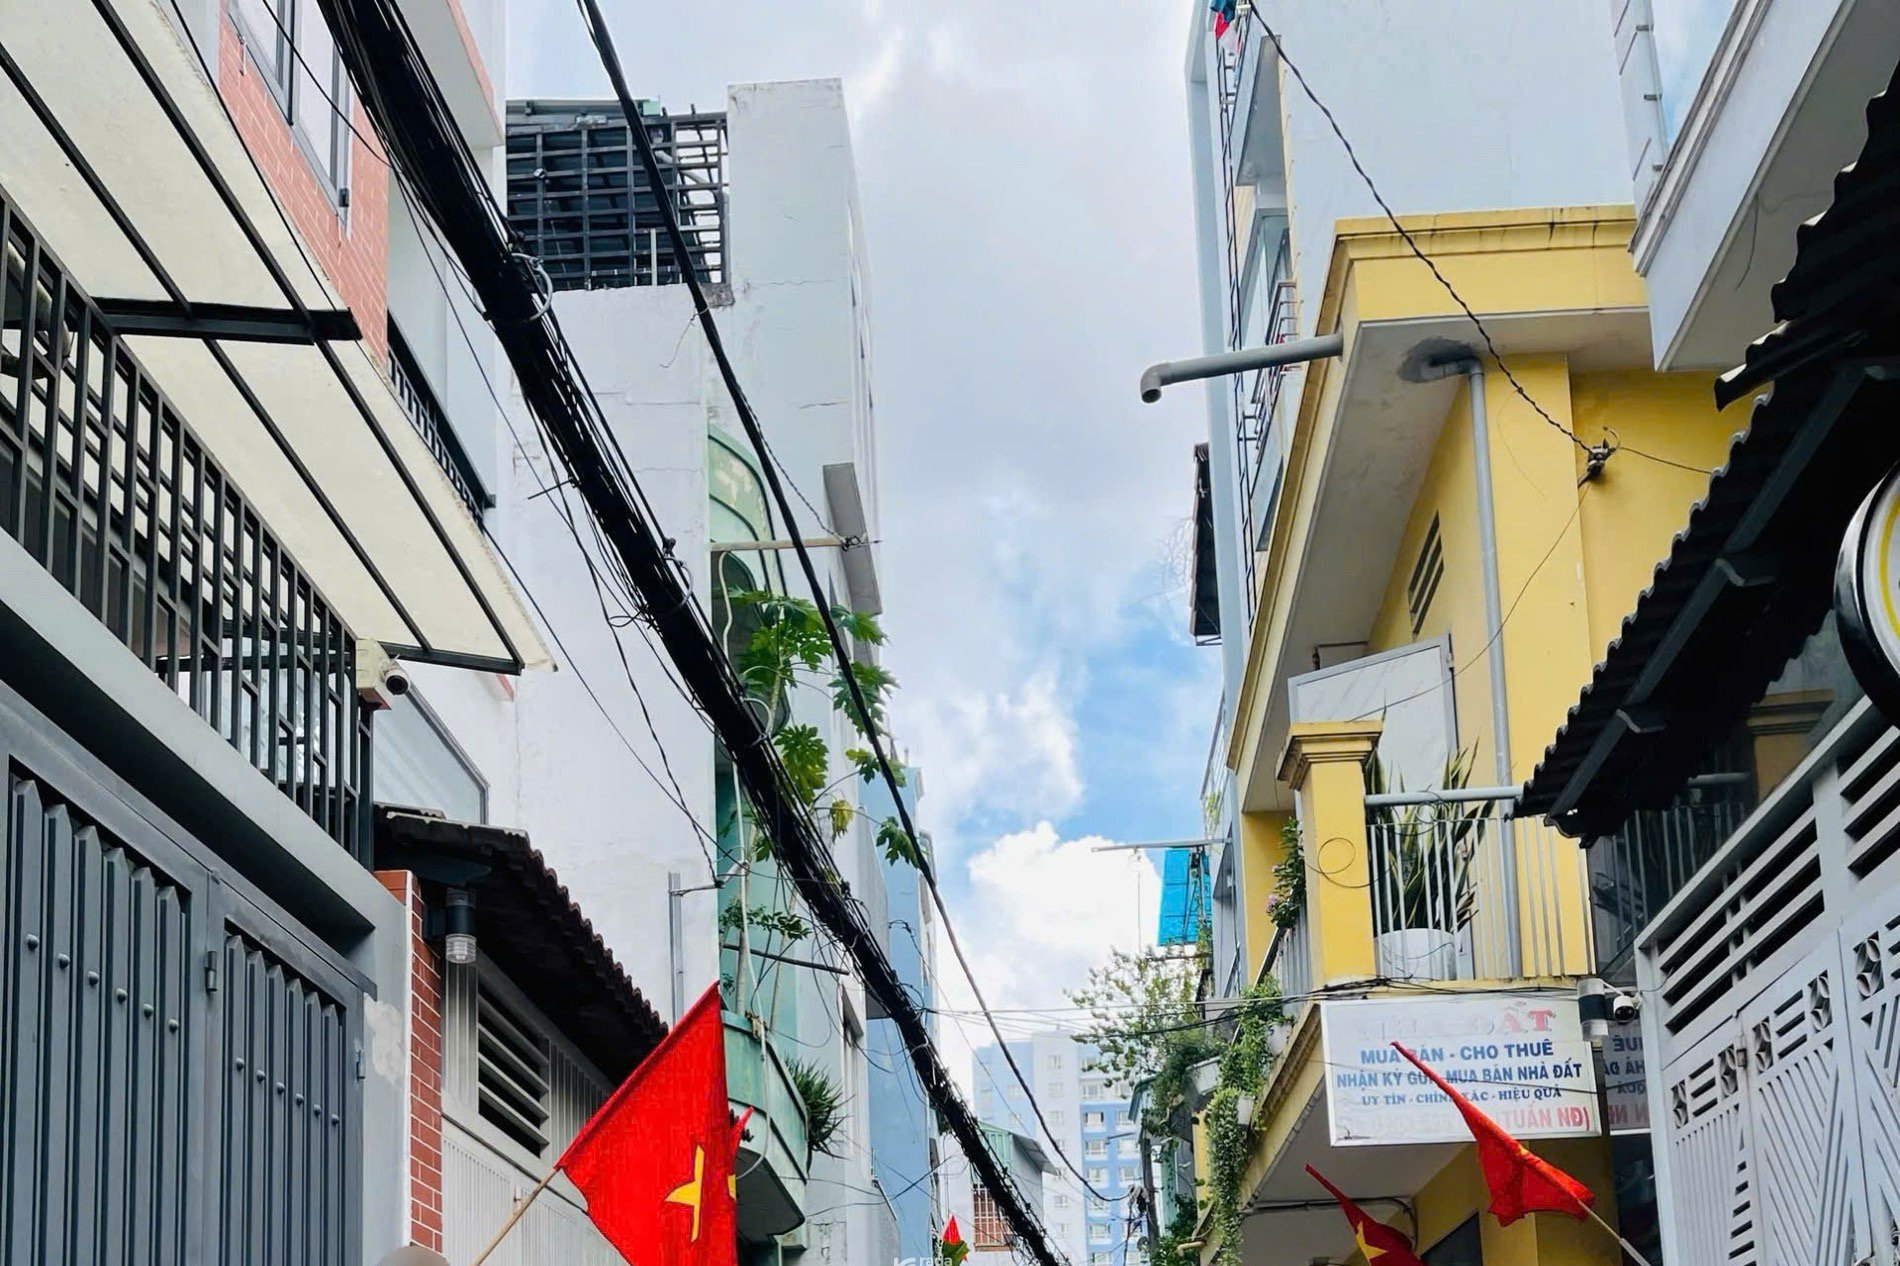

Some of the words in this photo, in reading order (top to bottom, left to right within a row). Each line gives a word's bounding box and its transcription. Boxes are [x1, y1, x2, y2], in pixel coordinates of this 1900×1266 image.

[1360, 1047, 1401, 1064] MUA
[1460, 1045, 1499, 1061] CHO
[1504, 1039, 1554, 1058] THUÊ
[1336, 1069, 1378, 1091] NHẬN
[1446, 1068, 1478, 1084] MUA
[1482, 1063, 1513, 1082] BÁN
[1517, 1061, 1549, 1081] NHÀ
[1553, 1057, 1582, 1079] ĐẤT
[1362, 1095, 1380, 1106] UY
[1416, 1090, 1453, 1103] CHÍN
[1498, 1086, 1530, 1101] HIỆU
